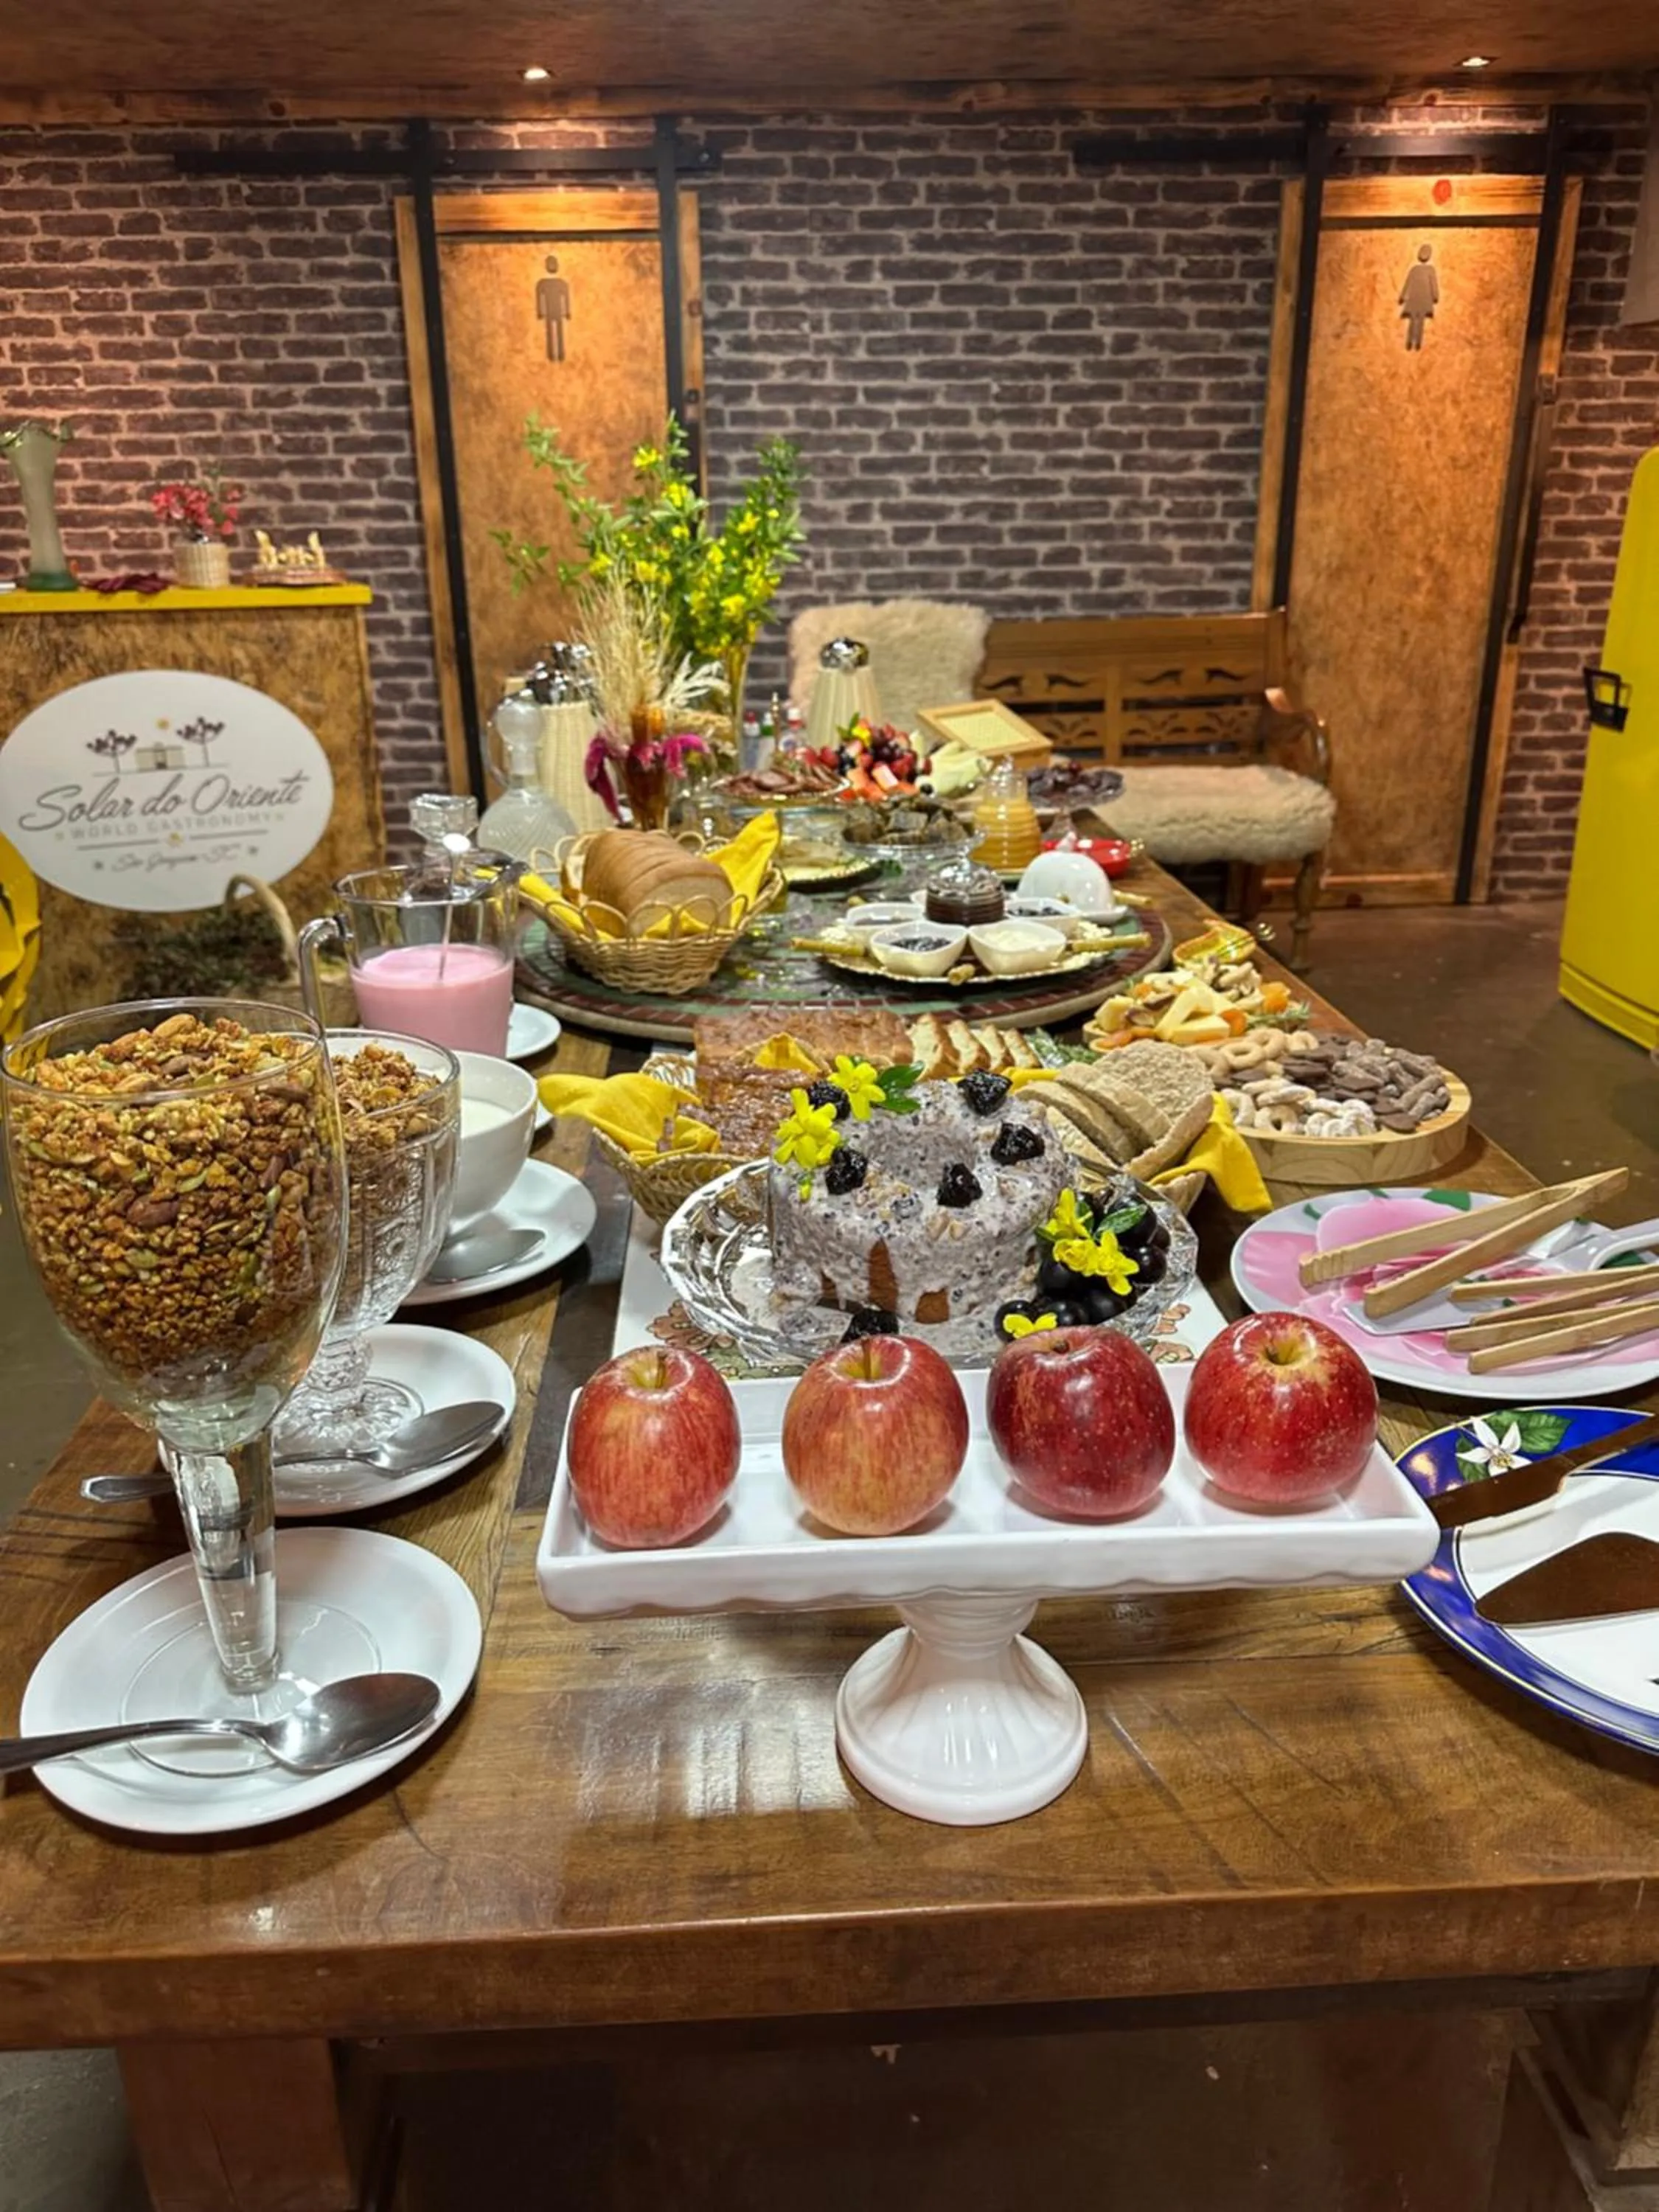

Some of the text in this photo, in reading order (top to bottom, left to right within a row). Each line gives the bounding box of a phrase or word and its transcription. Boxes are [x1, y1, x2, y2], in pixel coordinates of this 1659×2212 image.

[18, 770, 310, 831] Solar do Oriente
[72, 813, 272, 839] WORLD GASTRONOMY
